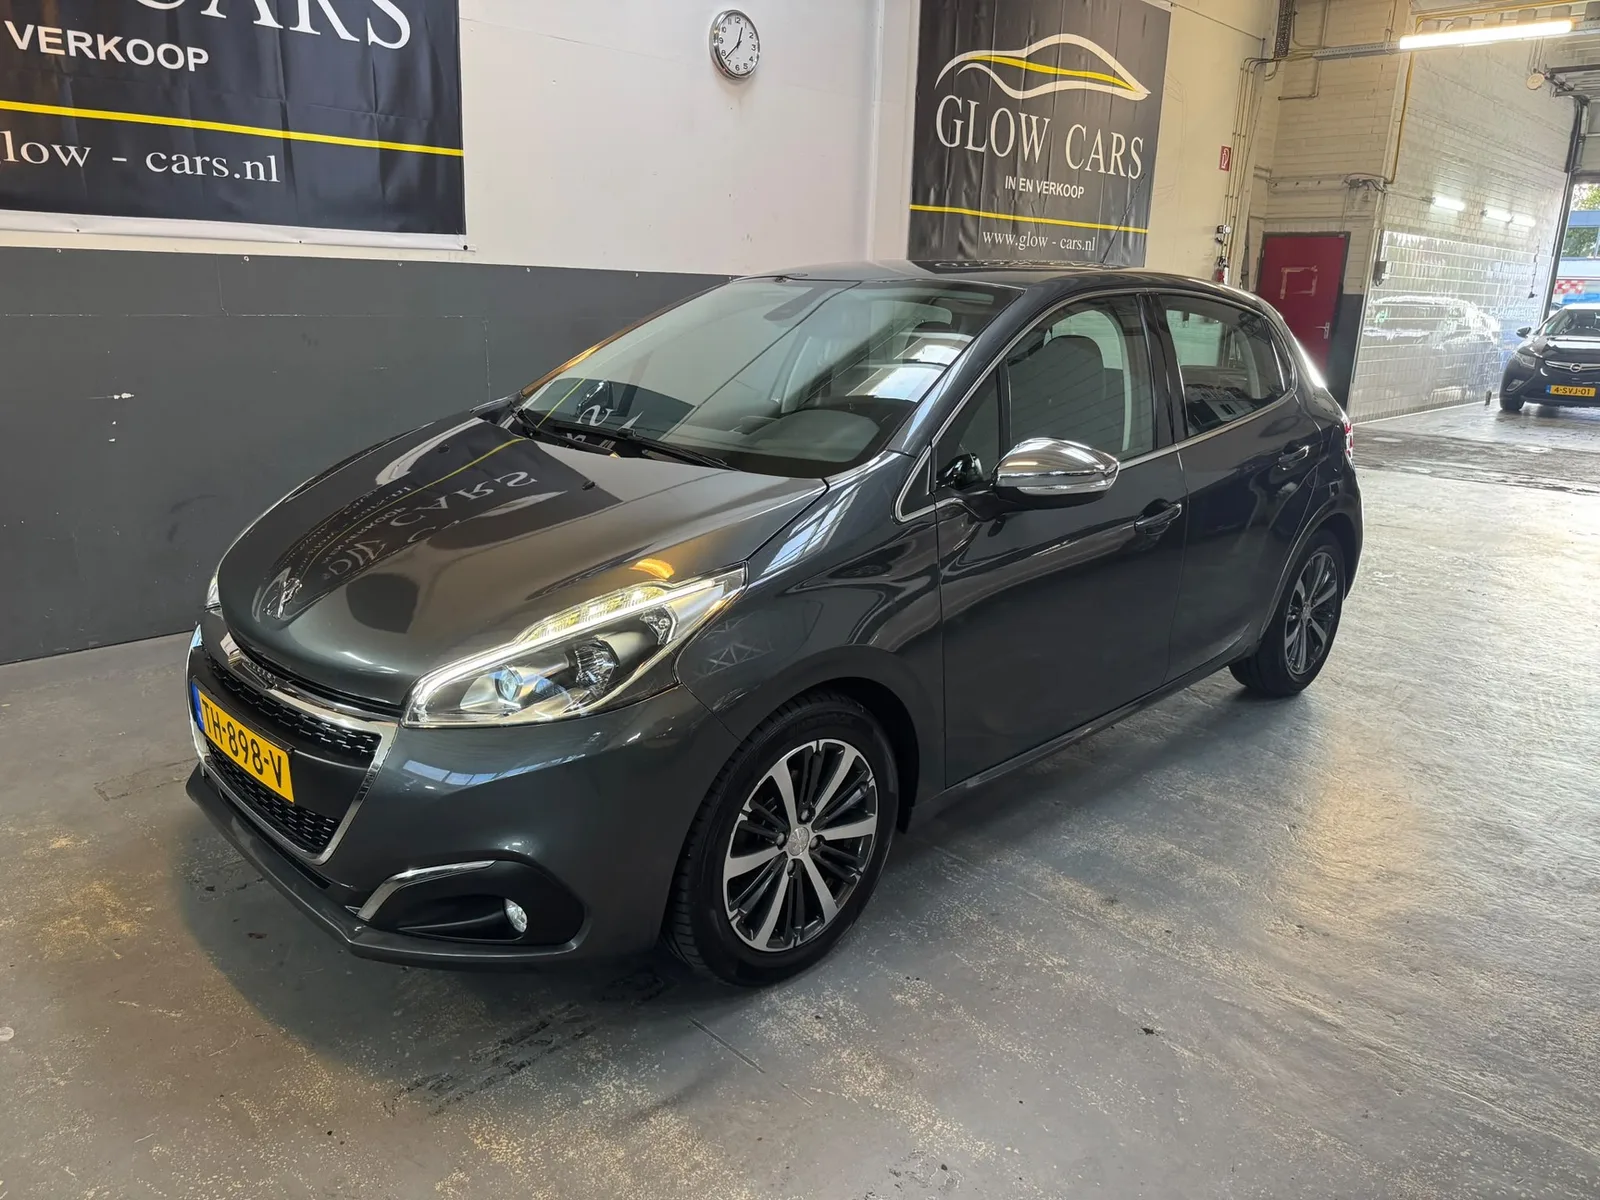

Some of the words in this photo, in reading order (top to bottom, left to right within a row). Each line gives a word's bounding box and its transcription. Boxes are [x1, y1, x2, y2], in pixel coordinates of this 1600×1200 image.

[4, 20, 209, 72] VERKOOP
[935, 94, 1051, 164] GLOW
[1065, 123, 1144, 180] CARS
[145, 151, 281, 183] cars.nl
[1005, 175, 1016, 190] IN
[1019, 178, 1033, 192] EN
[1036, 181, 1085, 199] VERKOOP
[982, 230, 1049, 251] www.glow
[1060, 237, 1096, 252] cars.nl
[202, 699, 282, 788] TH-898-V
